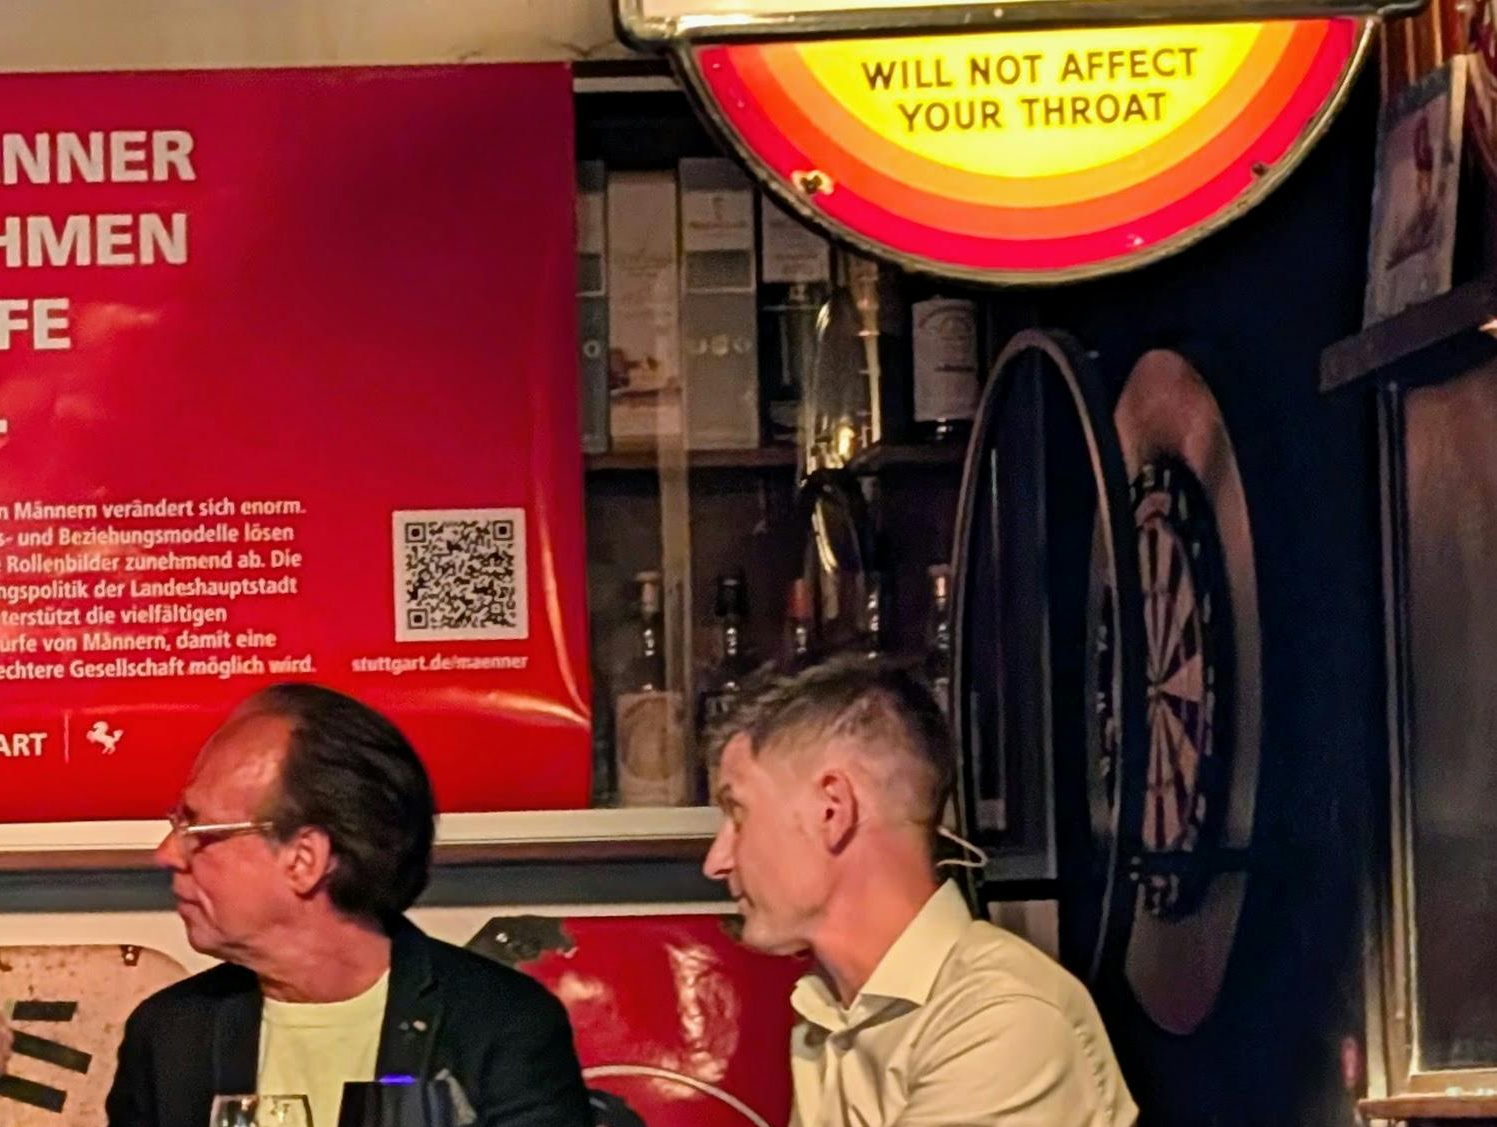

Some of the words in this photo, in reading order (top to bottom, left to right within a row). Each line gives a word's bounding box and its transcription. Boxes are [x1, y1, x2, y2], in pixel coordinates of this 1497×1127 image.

[861, 58, 952, 91] WILL
[970, 54, 1042, 86] NOT
[1061, 47, 1198, 82] AFFECT
[898, 100, 1002, 133] YOUR
[1021, 91, 1167, 127] THROAT
[14, 500, 97, 520] Männern
[103, 498, 194, 518] verändert
[199, 497, 234, 516] sich
[240, 499, 306, 516] enorm.
[18, 527, 53, 546] und
[58, 522, 239, 548] Beziehungsmodelle
[244, 522, 294, 542] lösen
[6, 552, 119, 574] Rollenbilder
[125, 550, 232, 571] zunehmend
[237, 549, 266, 569] ab.
[271, 548, 302, 568] Die
[94, 579, 125, 598] der
[131, 575, 297, 600] Landeshauptstadt
[86, 605, 115, 625] die
[120, 603, 227, 627] vielfältigen
[43, 637, 77, 652] von
[83, 630, 171, 651] Männern,
[176, 629, 231, 650] damit
[236, 629, 277, 648] eine
[70, 656, 185, 680] Gesellschaft
[189, 654, 265, 679] möglich
[268, 654, 317, 674] wird.
